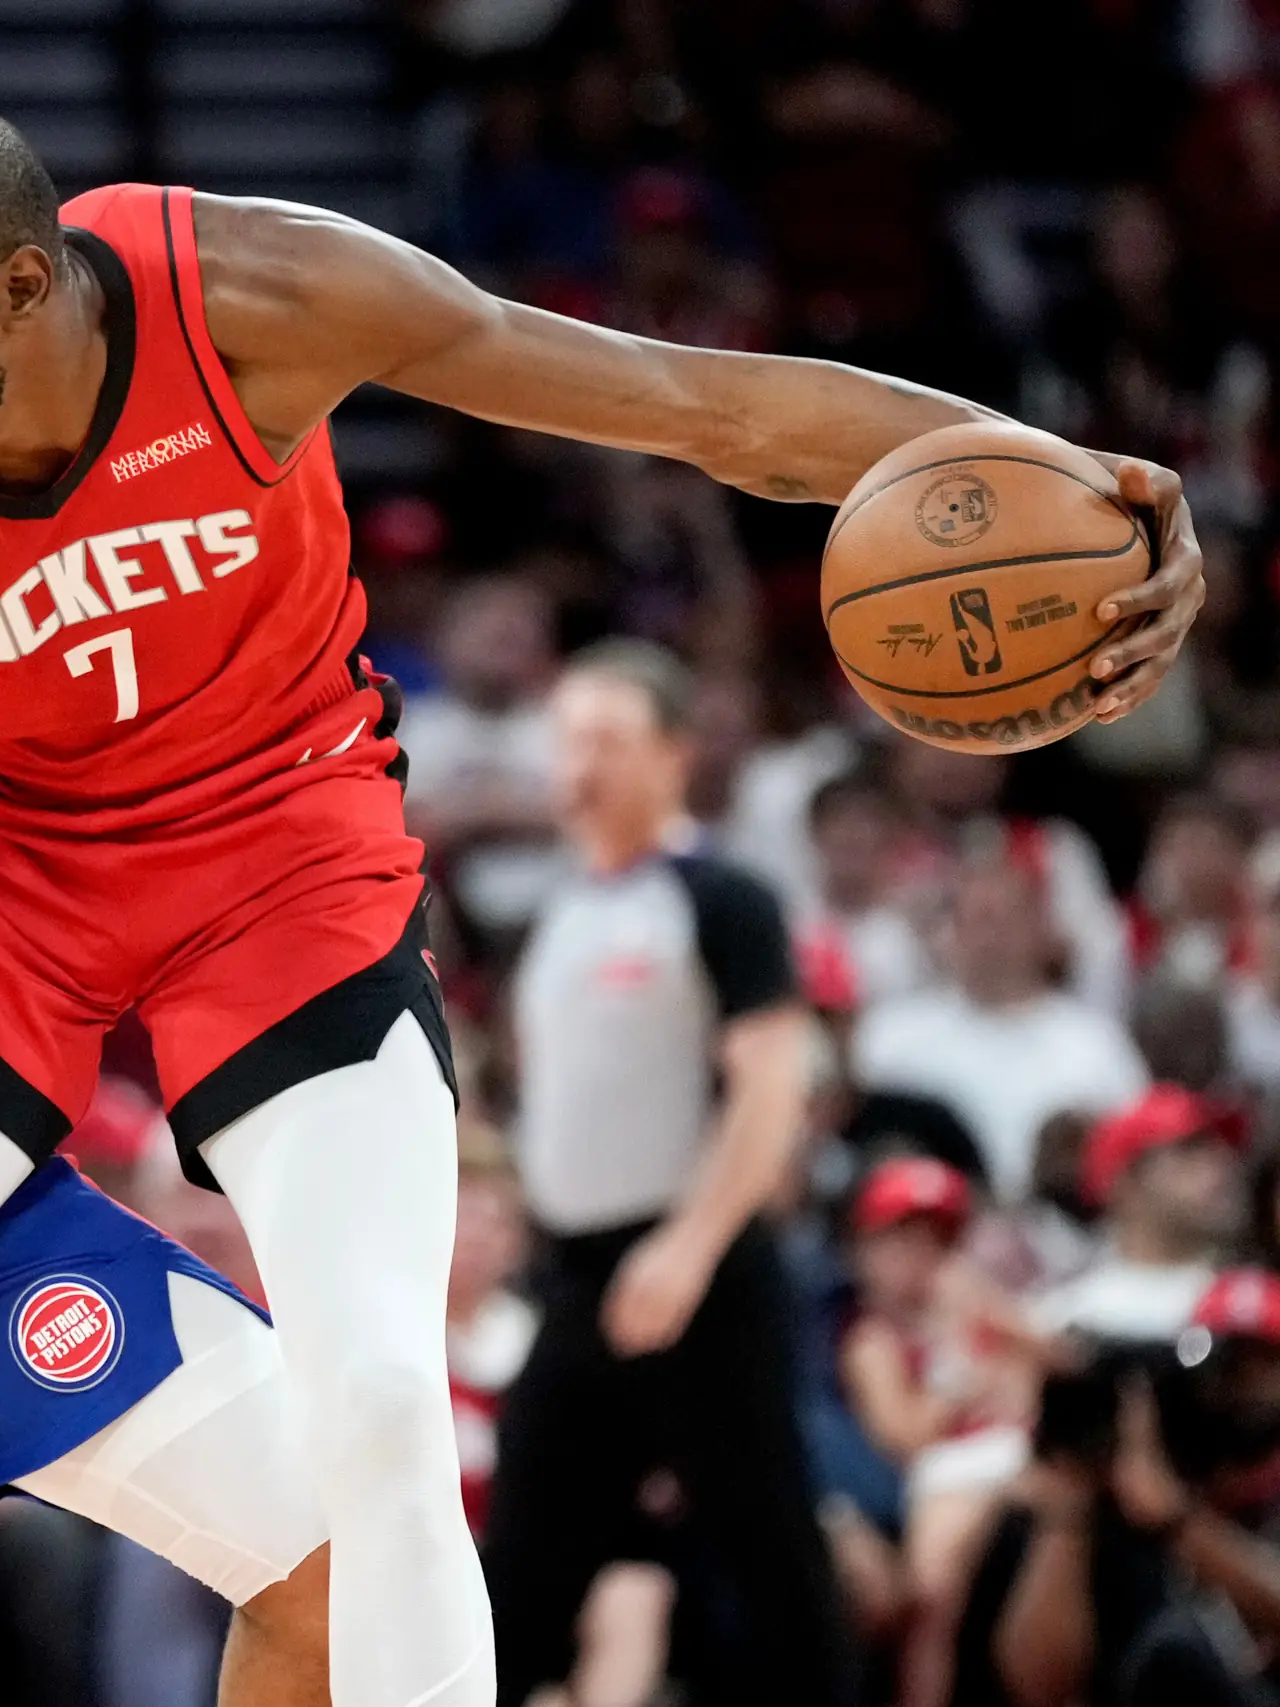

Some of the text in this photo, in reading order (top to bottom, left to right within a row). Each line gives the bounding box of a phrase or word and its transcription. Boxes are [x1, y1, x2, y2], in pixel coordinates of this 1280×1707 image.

[110, 423, 206, 473] MEMORIAL
[112, 430, 212, 483] HERMANN
[62, 627, 140, 724] 7
[29, 1298, 91, 1350] DETROIT
[39, 1313, 103, 1366] PISTONS
